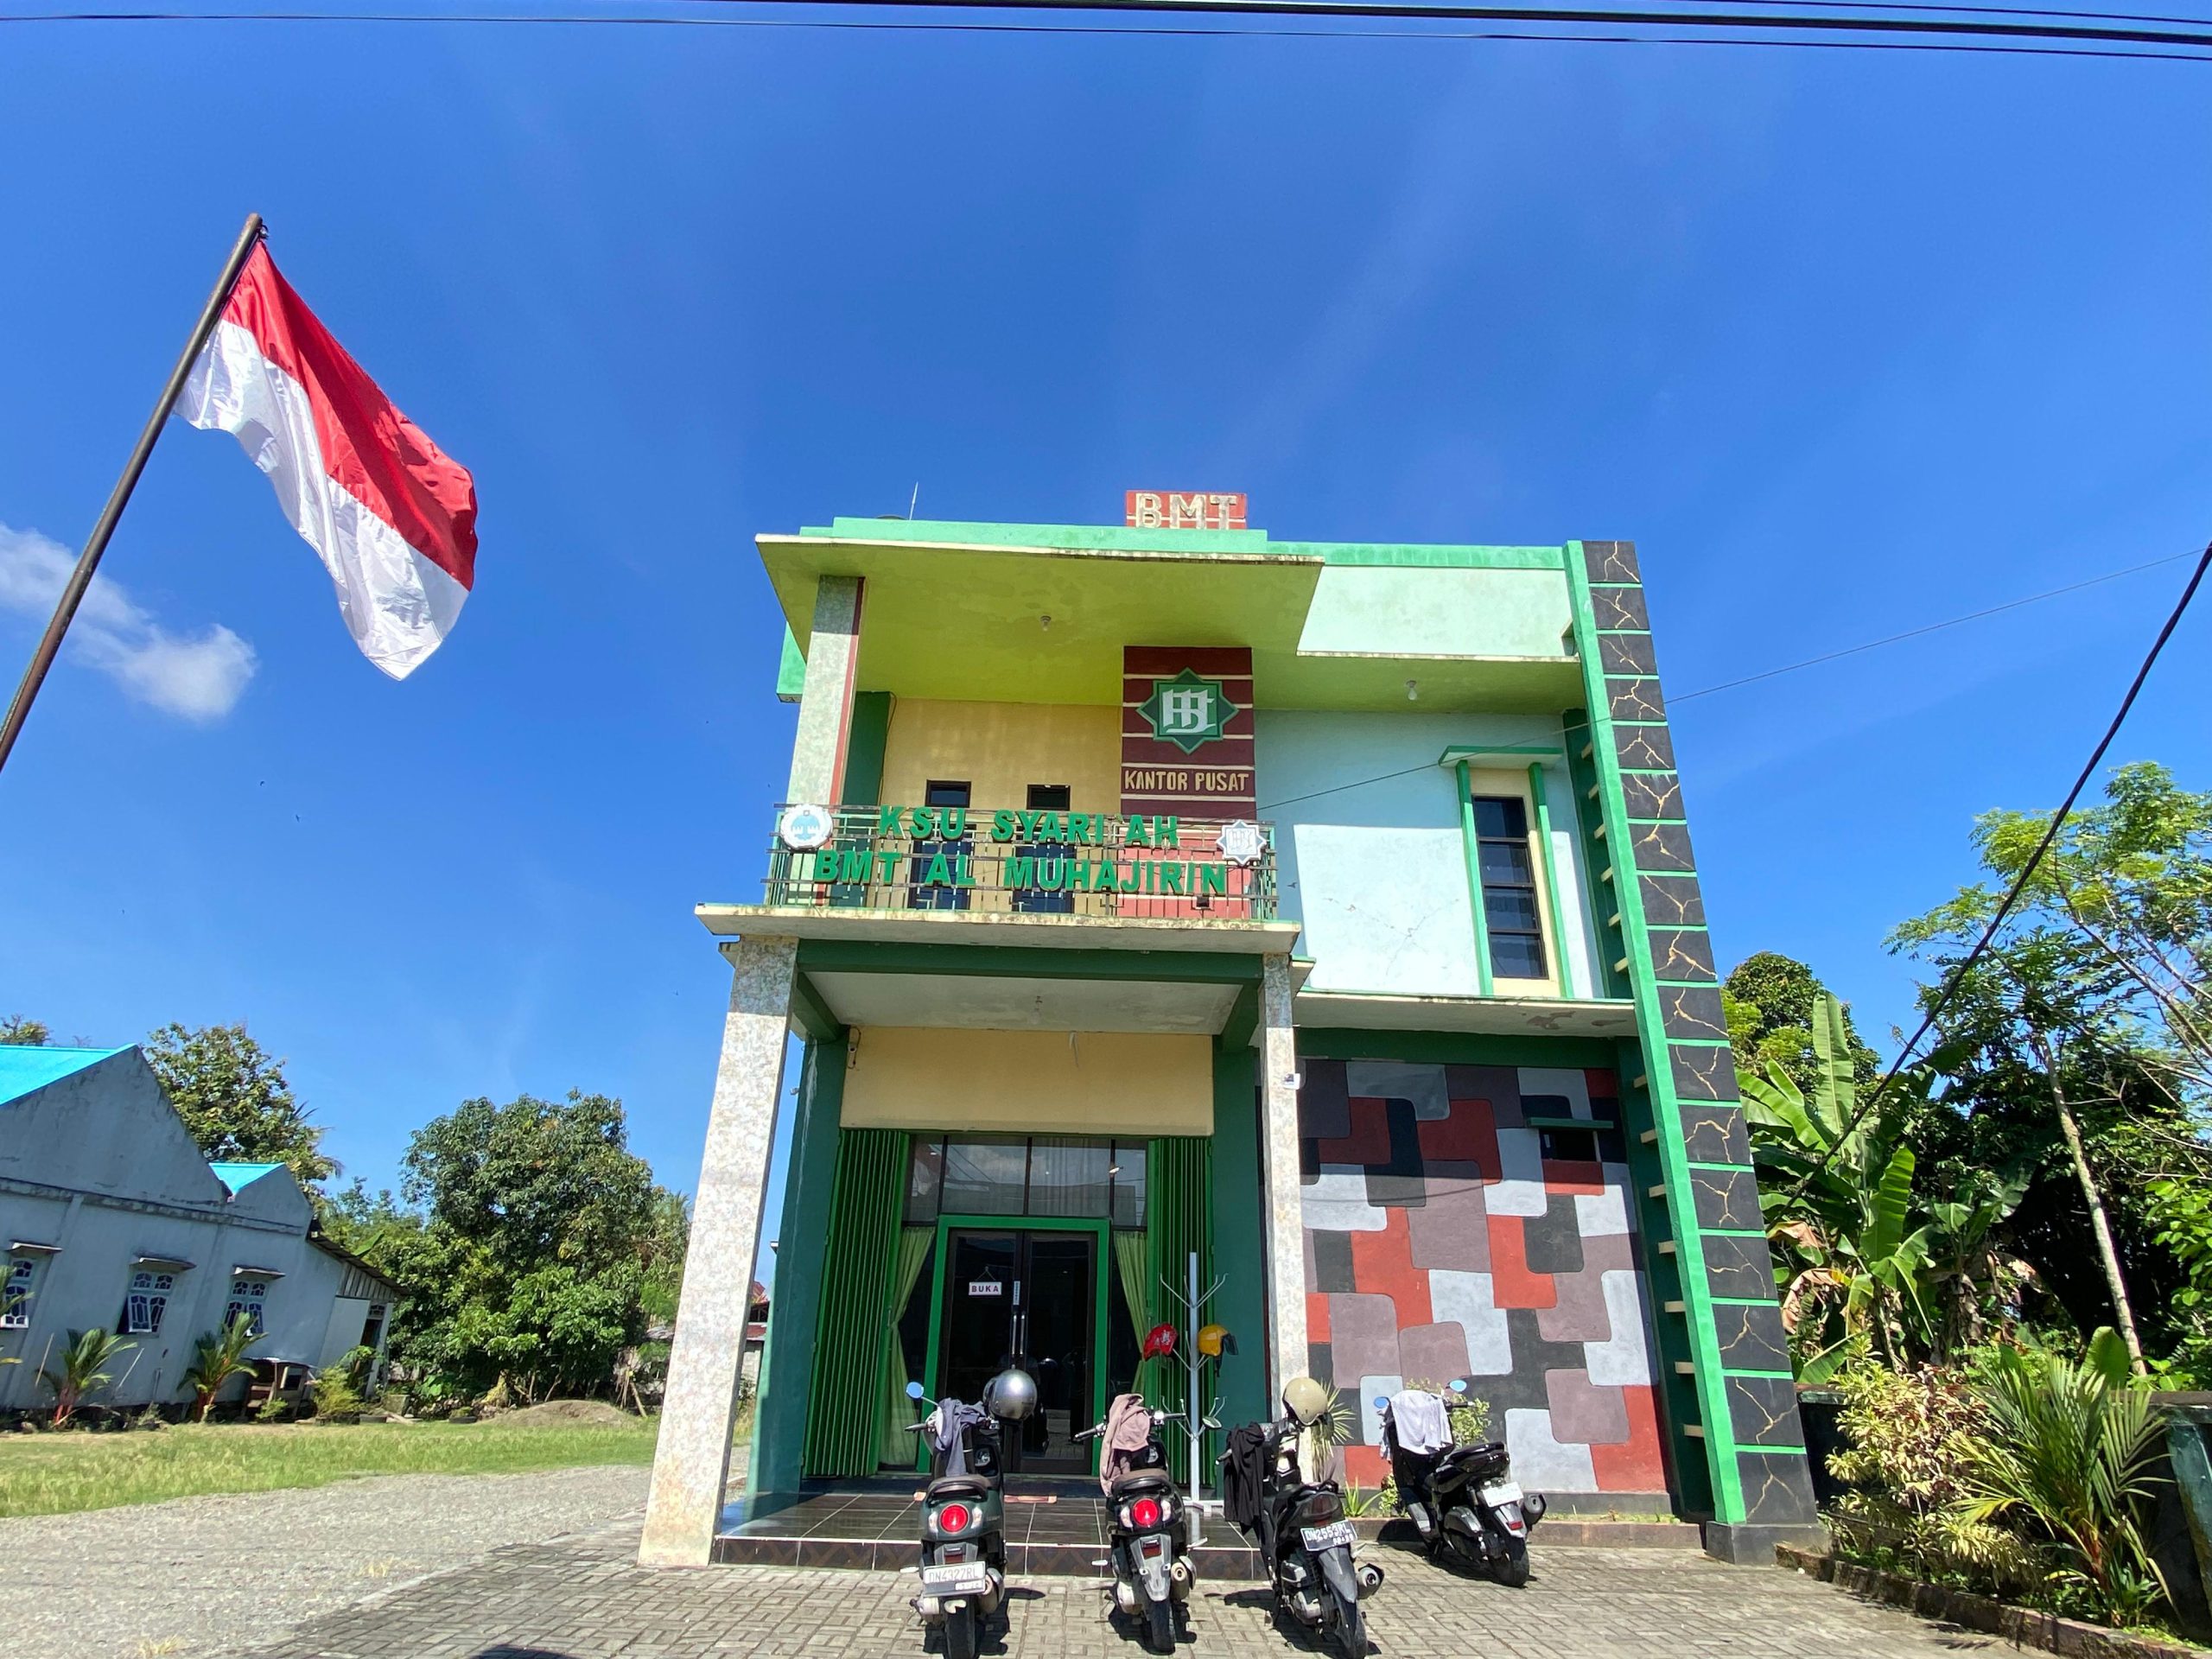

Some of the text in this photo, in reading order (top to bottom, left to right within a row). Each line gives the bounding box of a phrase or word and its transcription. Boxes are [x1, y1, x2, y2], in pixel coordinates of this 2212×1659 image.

[1135, 493, 1237, 530] BMT
[1124, 770, 1249, 791] KANTOR PUSAT
[878, 804, 967, 841] KSU
[813, 849, 1226, 895] BMT AL MUHAJIRIN
[928, 1567, 978, 1583] DN4327RL
